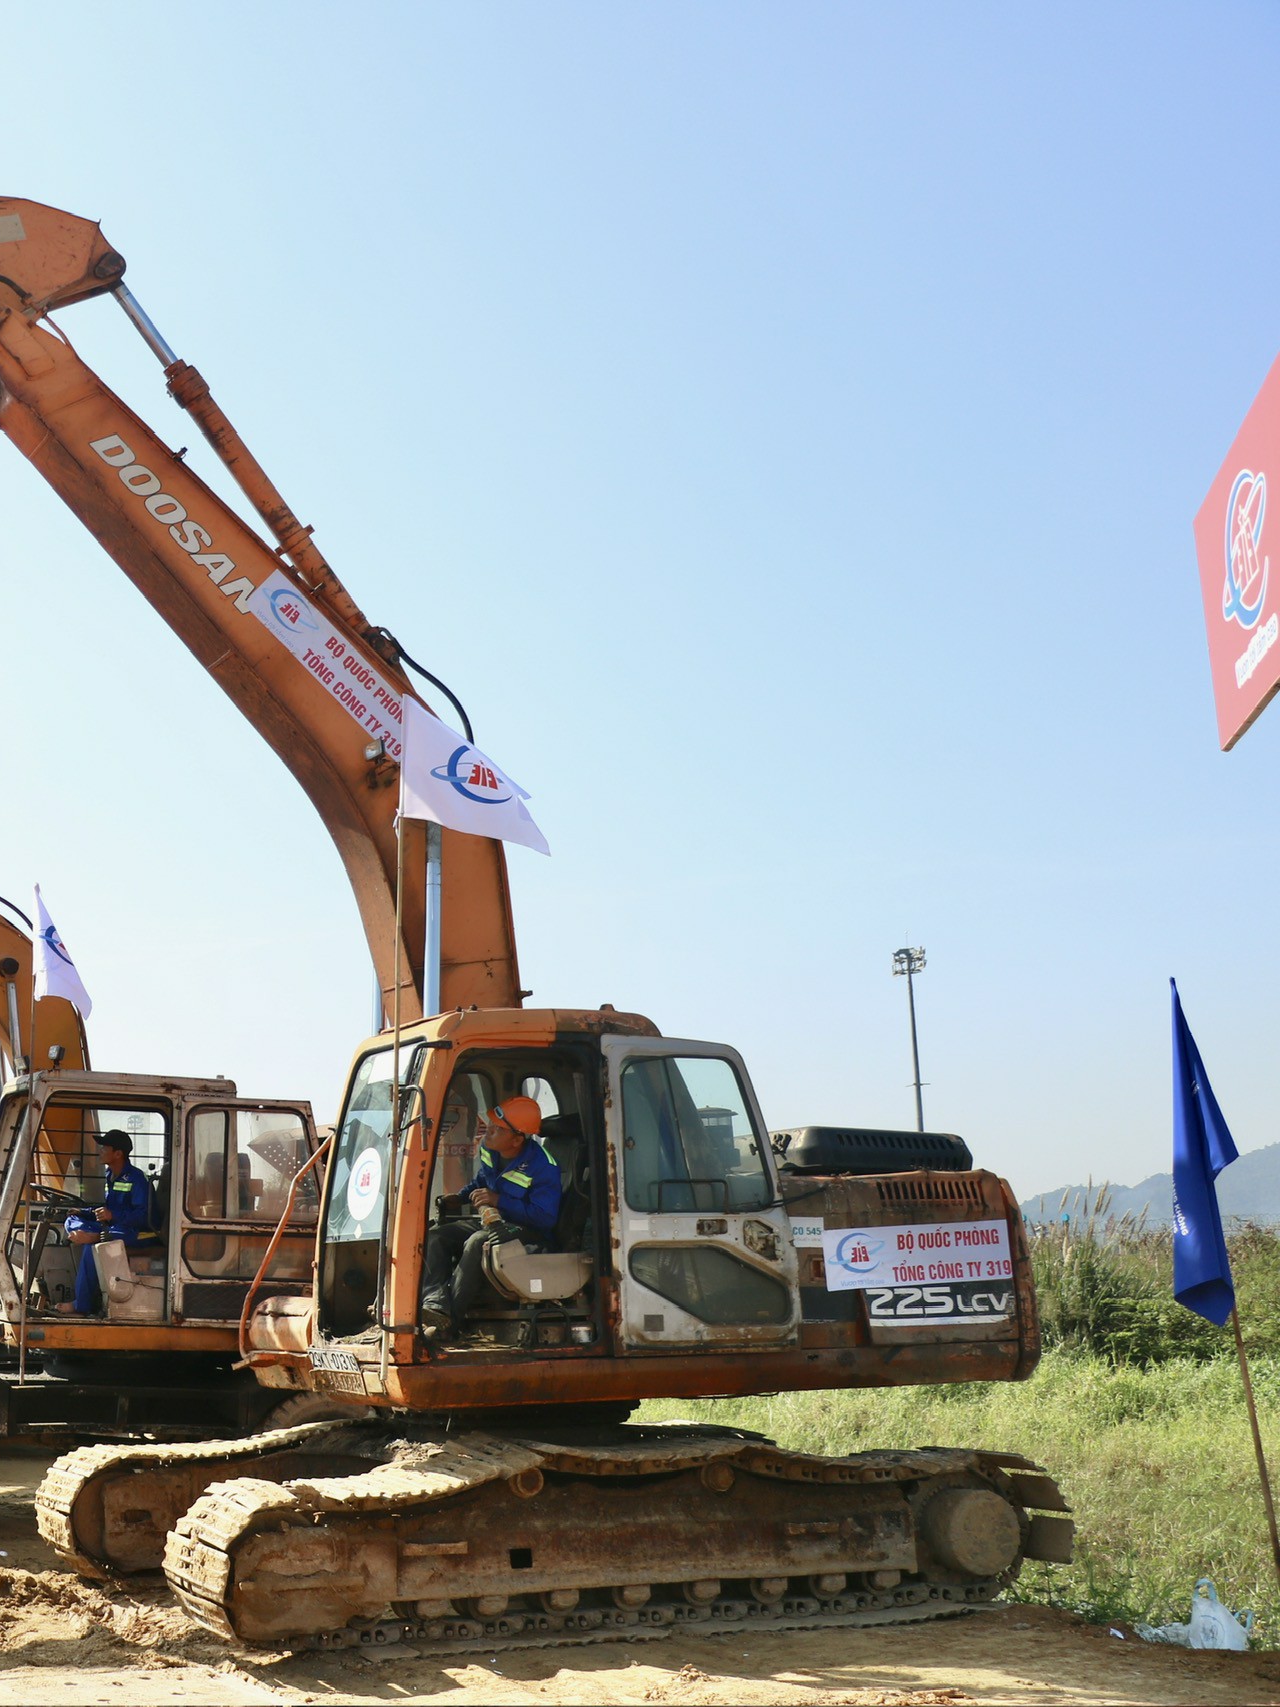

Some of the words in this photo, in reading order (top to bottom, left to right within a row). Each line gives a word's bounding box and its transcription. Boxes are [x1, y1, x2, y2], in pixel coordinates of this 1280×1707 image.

[89, 433, 255, 615] DOOSAN
[302, 648, 335, 685] TỔNG
[332, 682, 367, 718] CÔNG
[364, 714, 382, 733] TY
[380, 730, 402, 757] 319
[325, 636, 345, 659] BỘ
[343, 657, 376, 691] QUỐC
[373, 687, 402, 724] PHÒN
[892, 1260, 925, 1283] TỔNG
[929, 1260, 964, 1281] CÔNG
[967, 1261, 982, 1278] TY
[986, 1259, 1012, 1276] 319
[897, 1230, 914, 1254] BỘ
[918, 1227, 951, 1250] QUỐC
[955, 1226, 1000, 1247] PHÒNG
